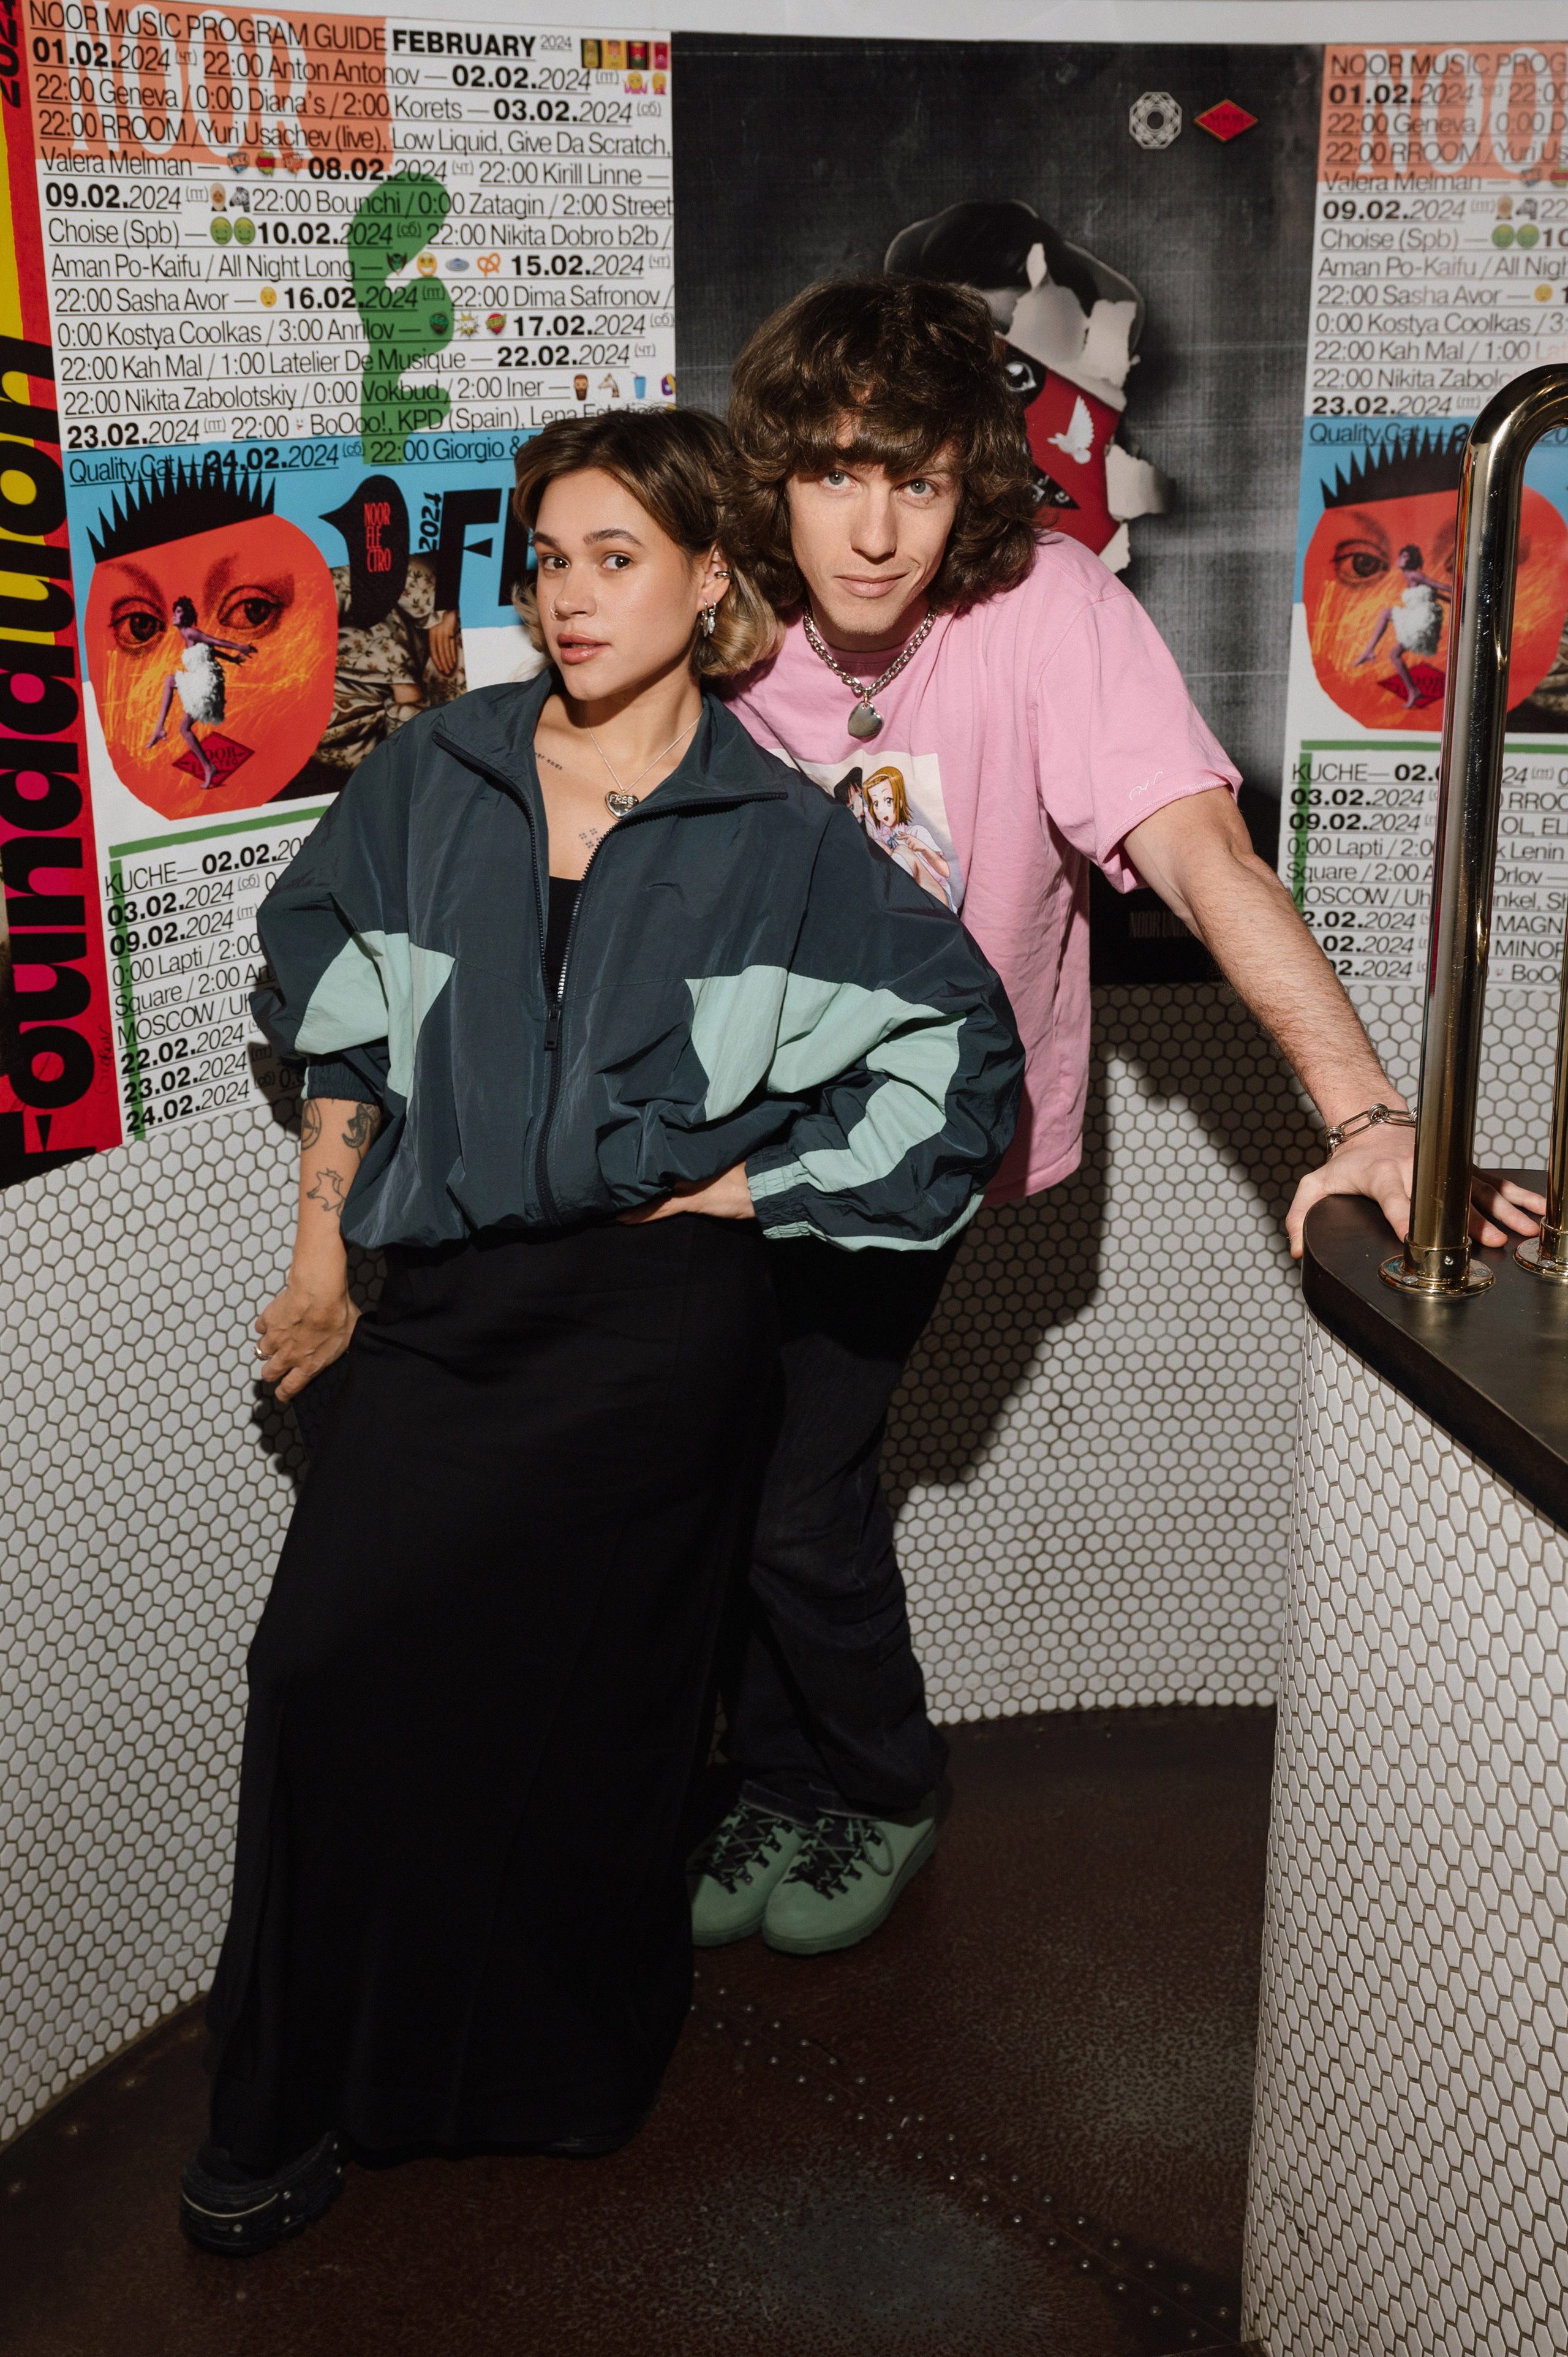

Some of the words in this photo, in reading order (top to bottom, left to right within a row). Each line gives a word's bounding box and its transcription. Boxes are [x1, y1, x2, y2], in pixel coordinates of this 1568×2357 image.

[30, 1, 99, 31] NOOR
[105, 8, 181, 39] MUSIC
[187, 15, 309, 48] PROGRAM
[315, 24, 386, 51] GUIDE
[393, 29, 536, 57] FEBRUARY
[540, 35, 572, 49] 2024
[33, 37, 170, 72] 01.02.2024
[204, 51, 263, 78] 22:00
[268, 58, 329, 82] Anton
[334, 59, 420, 86] Antonov
[1331, 53, 1403, 75] NOOR
[1411, 53, 1490, 75] MUSIC
[453, 65, 591, 92] 02.02.2024
[36, 74, 94, 102] 22:00
[99, 79, 178, 108] Geneva
[196, 85, 243, 110] 0:00
[343, 93, 389, 118] 2:00
[395, 95, 462, 119] Korets
[1330, 83, 1474, 105] 01.02.2024
[494, 99, 632, 124] 03.02.2024
[1328, 113, 1389, 134] 22:00
[1394, 113, 1476, 134] Geneva
[1496, 111, 1545, 132] 0:00
[40, 110, 97, 138] 22:00
[102, 115, 186, 143] RROOM
[245, 123, 332, 148] Usachev
[393, 129, 434, 151] Low
[439, 130, 502, 157] Liquid,
[508, 134, 552, 154] Give
[557, 133, 585, 154] Da
[589, 133, 671, 158] Scratch,
[40, 147, 106, 175] Valera
[111, 151, 192, 176] Melman
[1326, 141, 1385, 163] 22:00
[1392, 141, 1480, 163] RROOM
[308, 157, 447, 182] 08.02.2024
[479, 160, 538, 184] 22:00
[543, 162, 582, 184] Kirill
[587, 163, 642, 184] Linne
[1324, 171, 1388, 191] Valera
[1393, 172, 1481, 191] Melman
[46, 182, 181, 209] 09.02.2024
[252, 188, 310, 213] 22:00
[316, 189, 401, 215] Bounchi
[418, 192, 465, 214] 0:00
[470, 193, 544, 219] Zatagin
[562, 194, 607, 216] 2:00
[612, 194, 674, 216] Street
[1322, 200, 1464, 220] 09.02.2024
[48, 218, 118, 244] Choise
[124, 220, 179, 247] (Spb)
[258, 221, 391, 245] 10.02.2024
[427, 224, 485, 246] 22:00
[491, 224, 541, 246] Nikita
[551, 224, 614, 246] Dobro
[618, 224, 658, 246] b2b
[1321, 228, 1393, 247] Choise
[1400, 228, 1458, 252] (Spb)
[52, 254, 110, 277] Aman
[116, 254, 201, 277] Po-Kaifu
[218, 255, 241, 277] All
[246, 255, 302, 282] Night
[306, 255, 355, 282] Long
[511, 255, 644, 276] 15.02.2024
[1318, 257, 1381, 276] Aman
[1385, 257, 1476, 276] Po-Kaifu
[55, 288, 111, 312] 22:00
[117, 288, 180, 311] Sasha
[184, 289, 228, 311] Avor
[285, 285, 418, 309] 16.02.2024
[451, 287, 509, 307] 22:00
[514, 287, 567, 307] Dima
[570, 285, 661, 306] Safronov
[1317, 285, 1378, 304] 22:00
[1383, 285, 1449, 304] Sasha
[1454, 286, 1501, 304] Avor
[58, 322, 102, 347] 0:00
[107, 322, 175, 350] Kostya
[179, 320, 262, 344] Coolkas
[279, 319, 323, 342] 3:00
[328, 317, 394, 341] Anrilov
[514, 315, 645, 336] 17.02.2024
[1316, 313, 1363, 333] 0:00
[1368, 313, 1438, 336] Kostya
[1444, 312, 1530, 333] Coolkas
[498, 344, 630, 367] 22.02.2024
[1314, 341, 1374, 360] 22:00
[1380, 341, 1420, 360] Kah
[1425, 341, 1463, 360] Mal
[61, 356, 118, 381] 22:00
[123, 355, 161, 379] Kah
[167, 353, 202, 377] Mal
[221, 352, 264, 375] 1:00
[270, 350, 340, 374] Latelier
[345, 350, 372, 371] De
[378, 347, 466, 373] Musique
[1313, 369, 1372, 388] 22:00
[1378, 369, 1434, 388] Nikita
[64, 390, 120, 415] 22:00
[126, 388, 179, 412] Nikita
[184, 383, 297, 410] Zabolotskiy
[315, 381, 358, 404] 0:00
[361, 378, 441, 402] Vokbud
[458, 377, 502, 399] 2:00
[507, 376, 544, 398] Iner
[1311, 396, 1452, 415] 23.02.2024
[67, 419, 200, 449] 23.02.2024
[232, 415, 288, 439] 22:00
[398, 410, 444, 431] KPD
[449, 407, 525, 432] (Spain),
[1310, 423, 1380, 444] Quality
[70, 454, 137, 484] Quality
[141, 453, 175, 480] Cat
[205, 444, 339, 475] 24.02.2024
[370, 439, 429, 464] 22:00
[433, 437, 504, 463] Giorgio
[364, 502, 390, 526] NOOR
[420, 492, 441, 551] 2024
[1291, 788, 1424, 807] 03.02.2024
[1289, 813, 1420, 831] 09.02.2024
[1337, 837, 1382, 860] Lapti
[1286, 862, 1357, 883] Square
[1375, 864, 1419, 881] 2:00
[107, 880, 233, 926] 03.02.2024
[110, 909, 233, 956] 09.02.2024
[113, 957, 154, 987] 0:00
[158, 946, 203, 976] Lapti
[218, 933, 261, 960] 2:00
[115, 984, 182, 1018] Square
[198, 966, 239, 995] 2:00
[117, 1000, 214, 1046] MOSCOW
[120, 1022, 244, 1073] 22.02.2024
[123, 1051, 247, 1103] 23.02.2024
[126, 1080, 249, 1133] 24.02.2024
